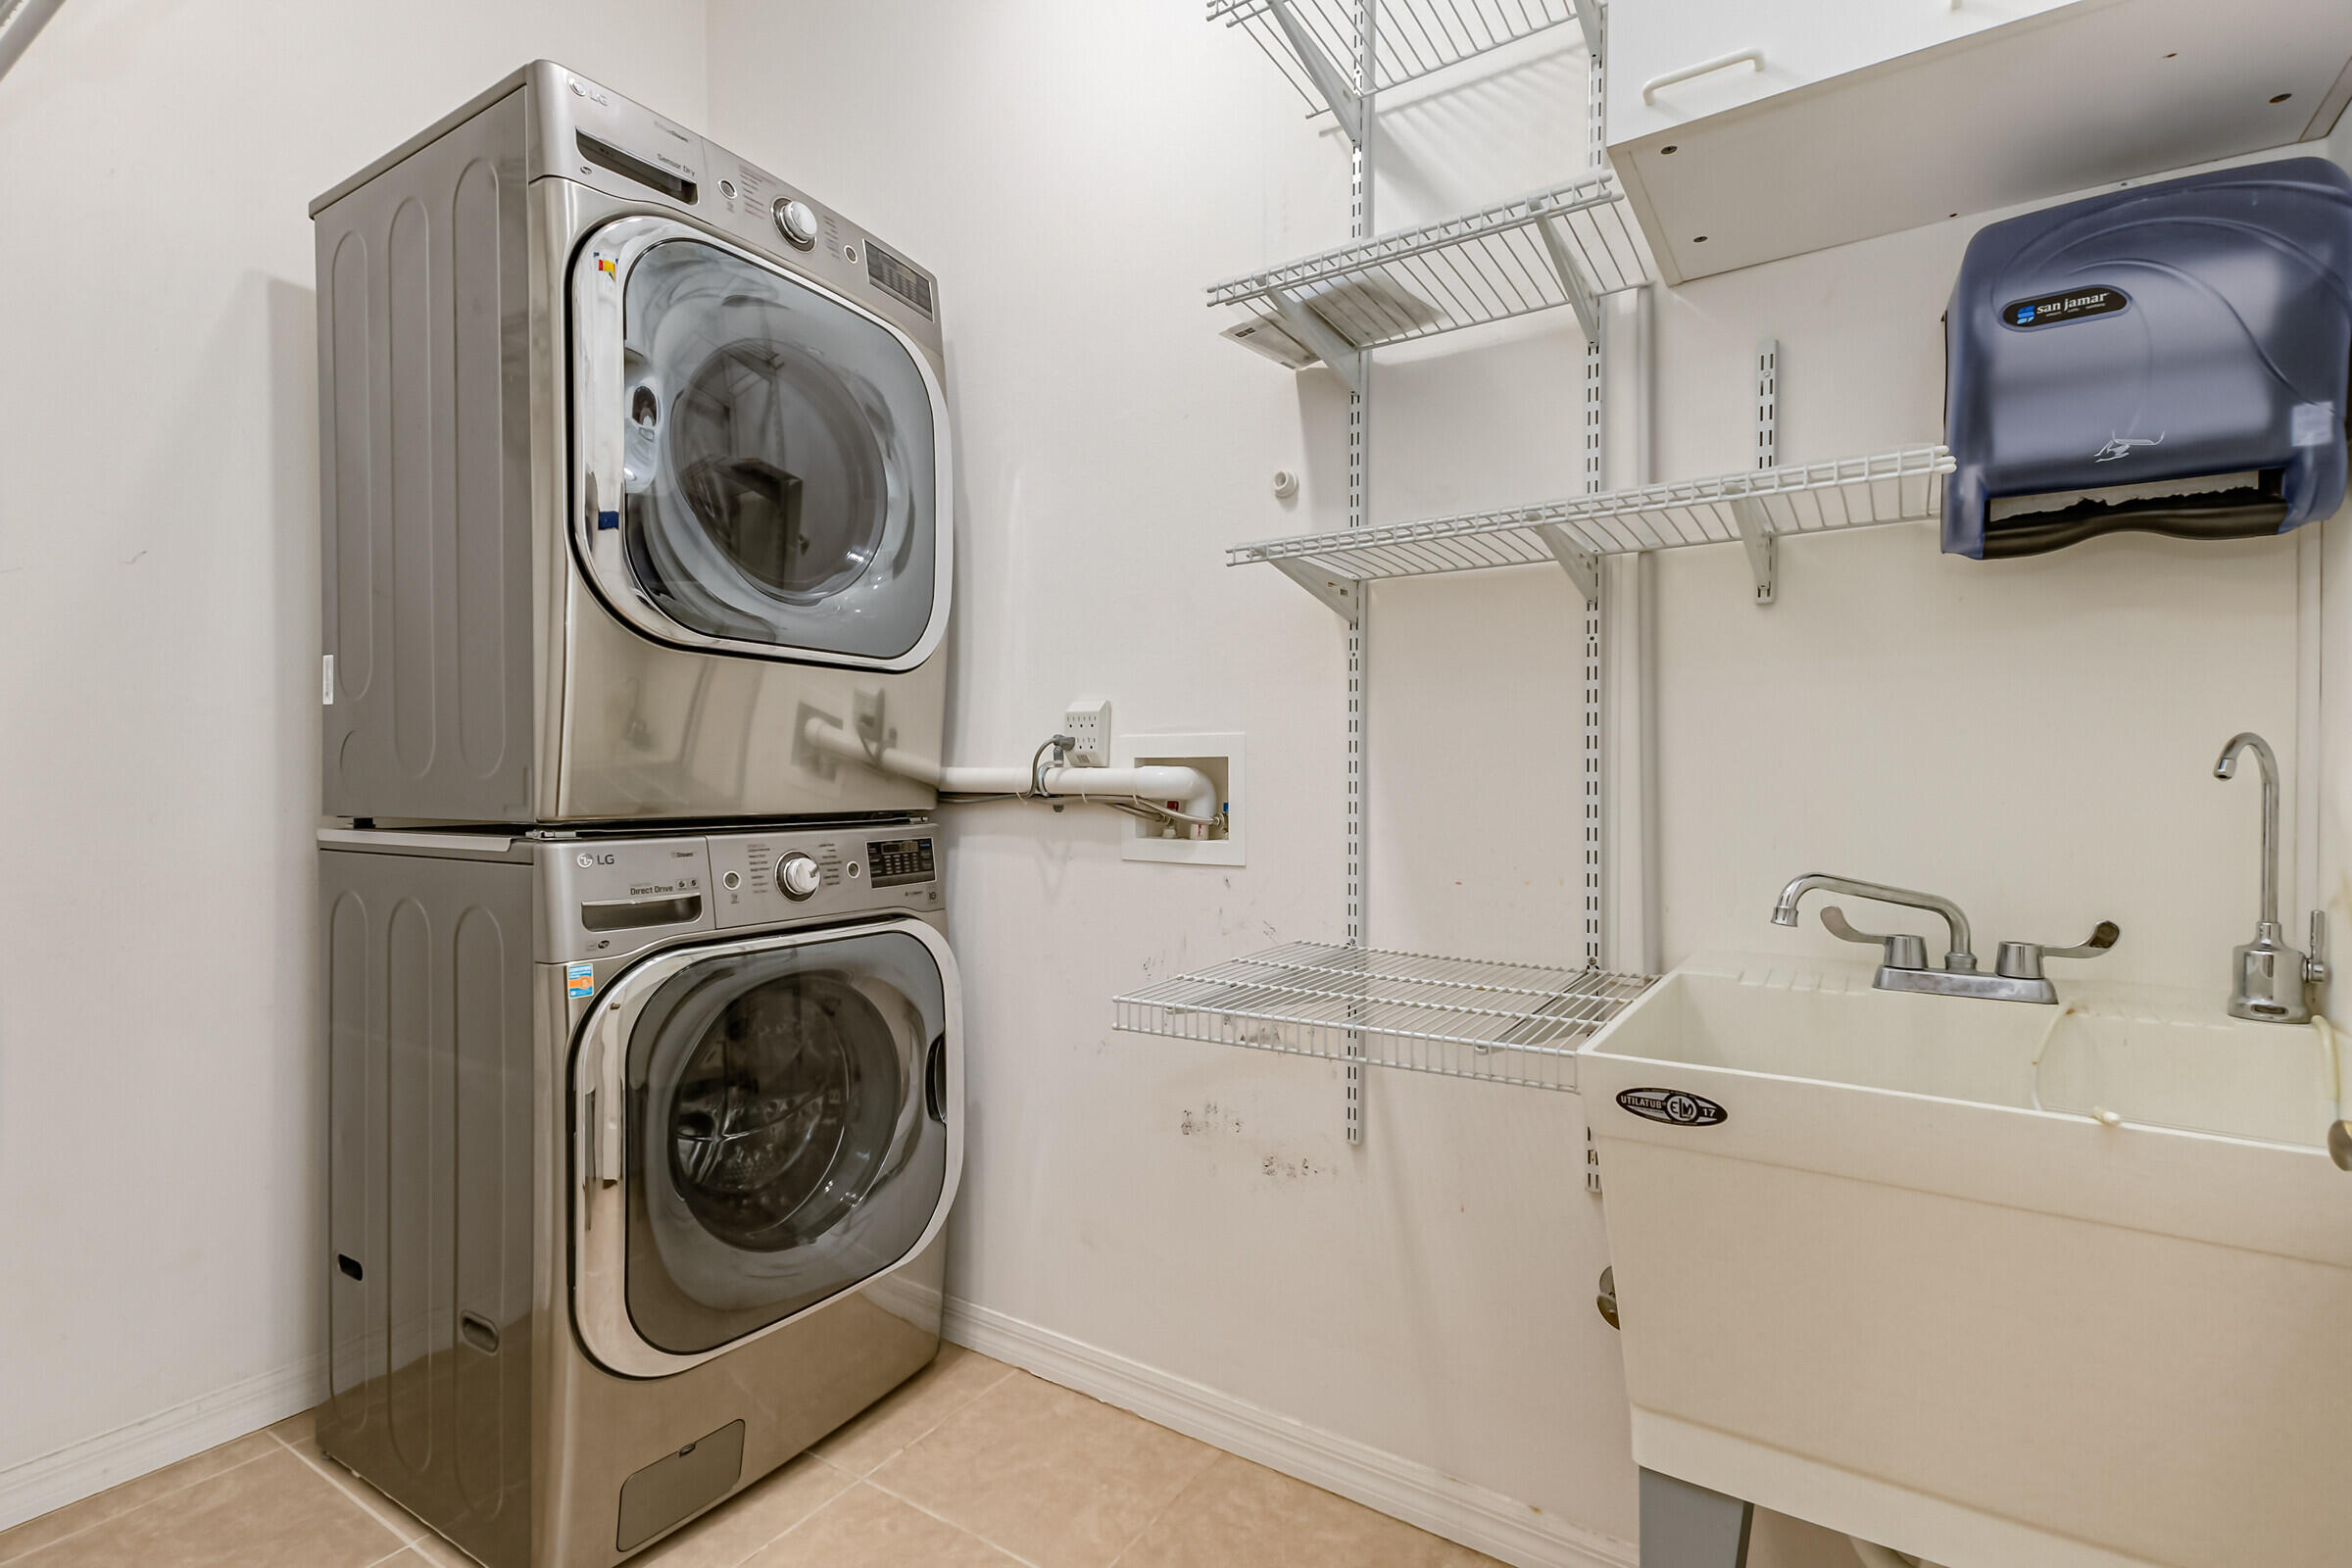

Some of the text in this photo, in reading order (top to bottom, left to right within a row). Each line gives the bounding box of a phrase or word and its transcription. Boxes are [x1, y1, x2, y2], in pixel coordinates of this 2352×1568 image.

[588, 89, 608, 107] LG
[2036, 303, 2061, 315] san
[2064, 293, 2107, 312] jamar
[597, 855, 614, 865] LG
[630, 886, 653, 896] Direct
[654, 885, 673, 894] Drive
[1620, 1095, 1662, 1109] UTILATUB
[1703, 1108, 1716, 1117] 17
